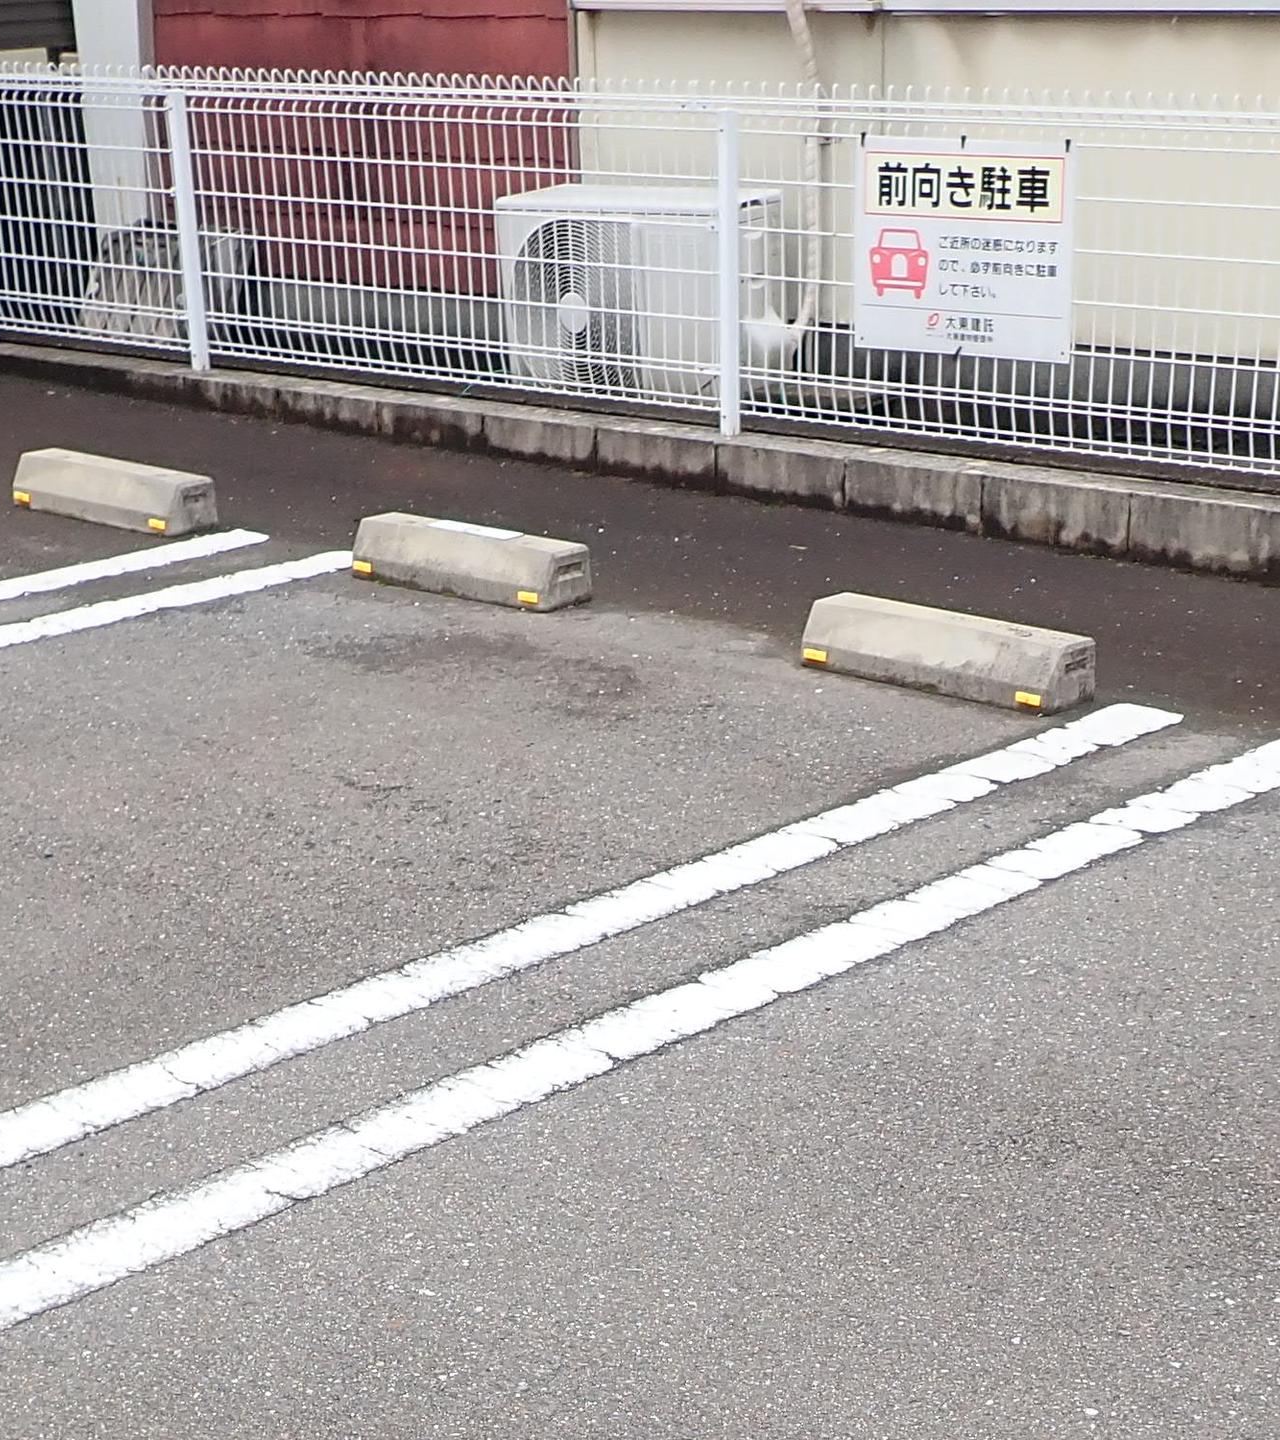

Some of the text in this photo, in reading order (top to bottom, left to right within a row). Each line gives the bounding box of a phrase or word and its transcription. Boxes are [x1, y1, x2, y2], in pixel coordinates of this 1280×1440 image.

[878, 162, 1051, 212] 前向き駐車
